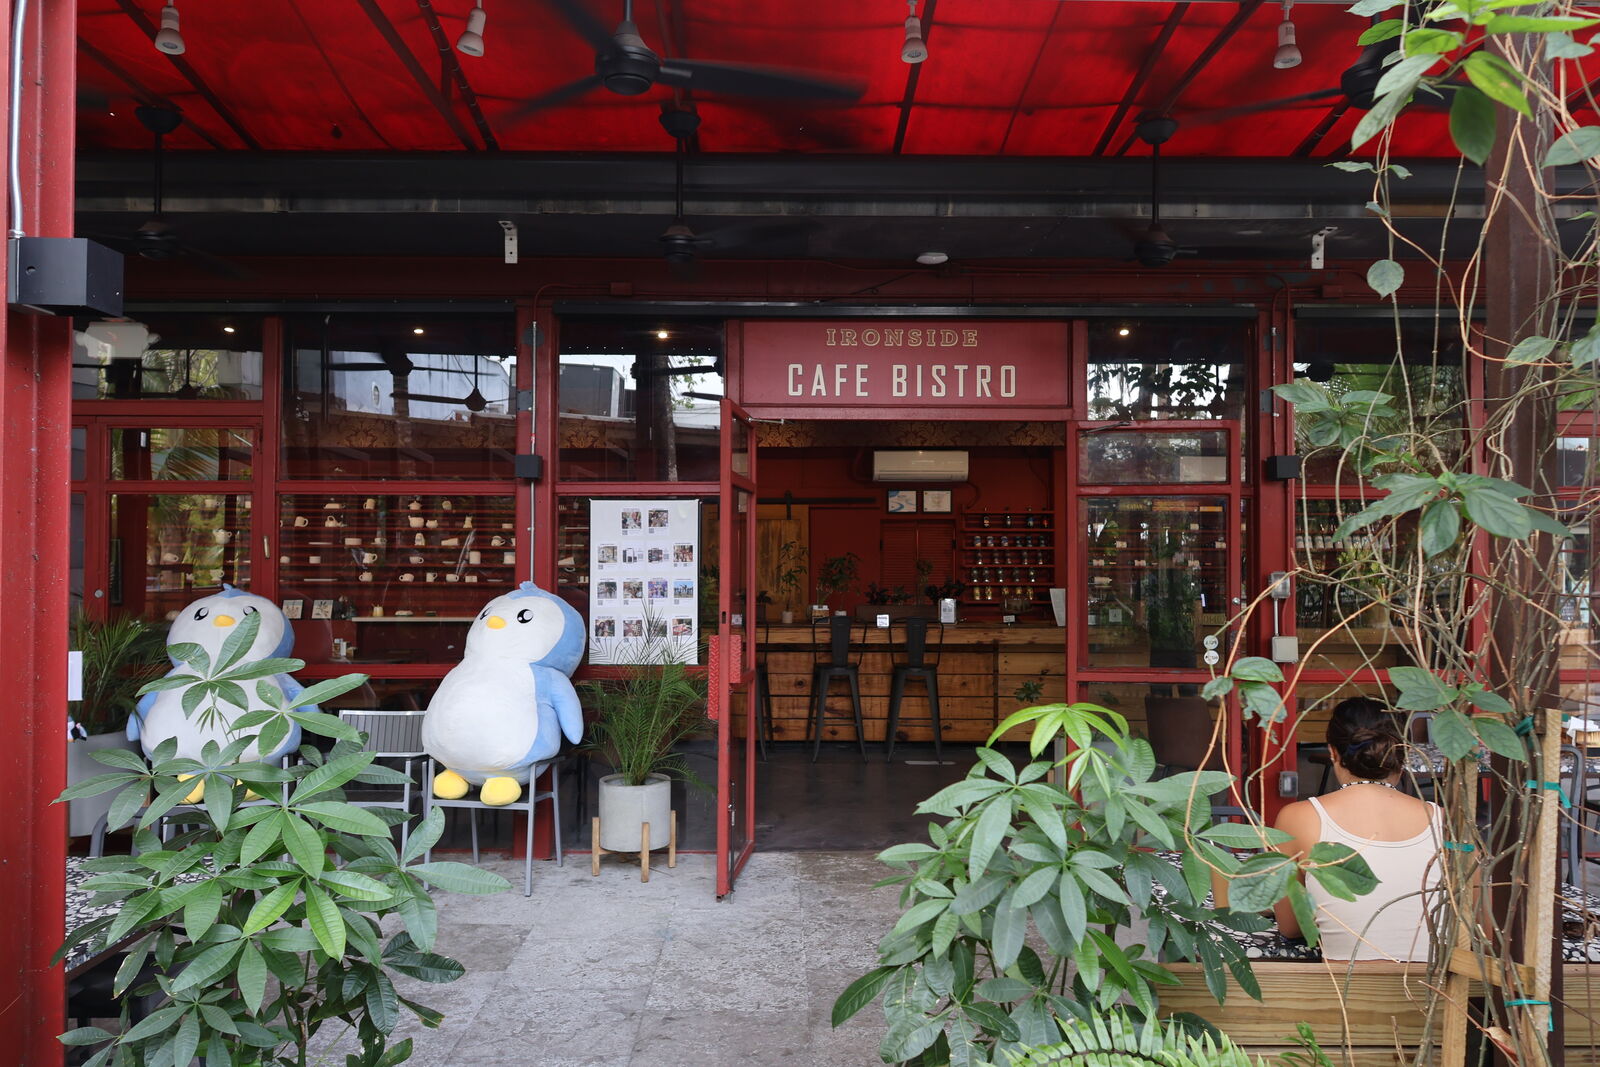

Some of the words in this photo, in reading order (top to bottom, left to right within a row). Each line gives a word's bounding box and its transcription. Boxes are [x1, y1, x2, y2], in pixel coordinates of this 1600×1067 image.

[826, 328, 978, 347] IRONSIDE
[787, 363, 869, 397] CAFE
[892, 363, 1016, 397] BISTRO
